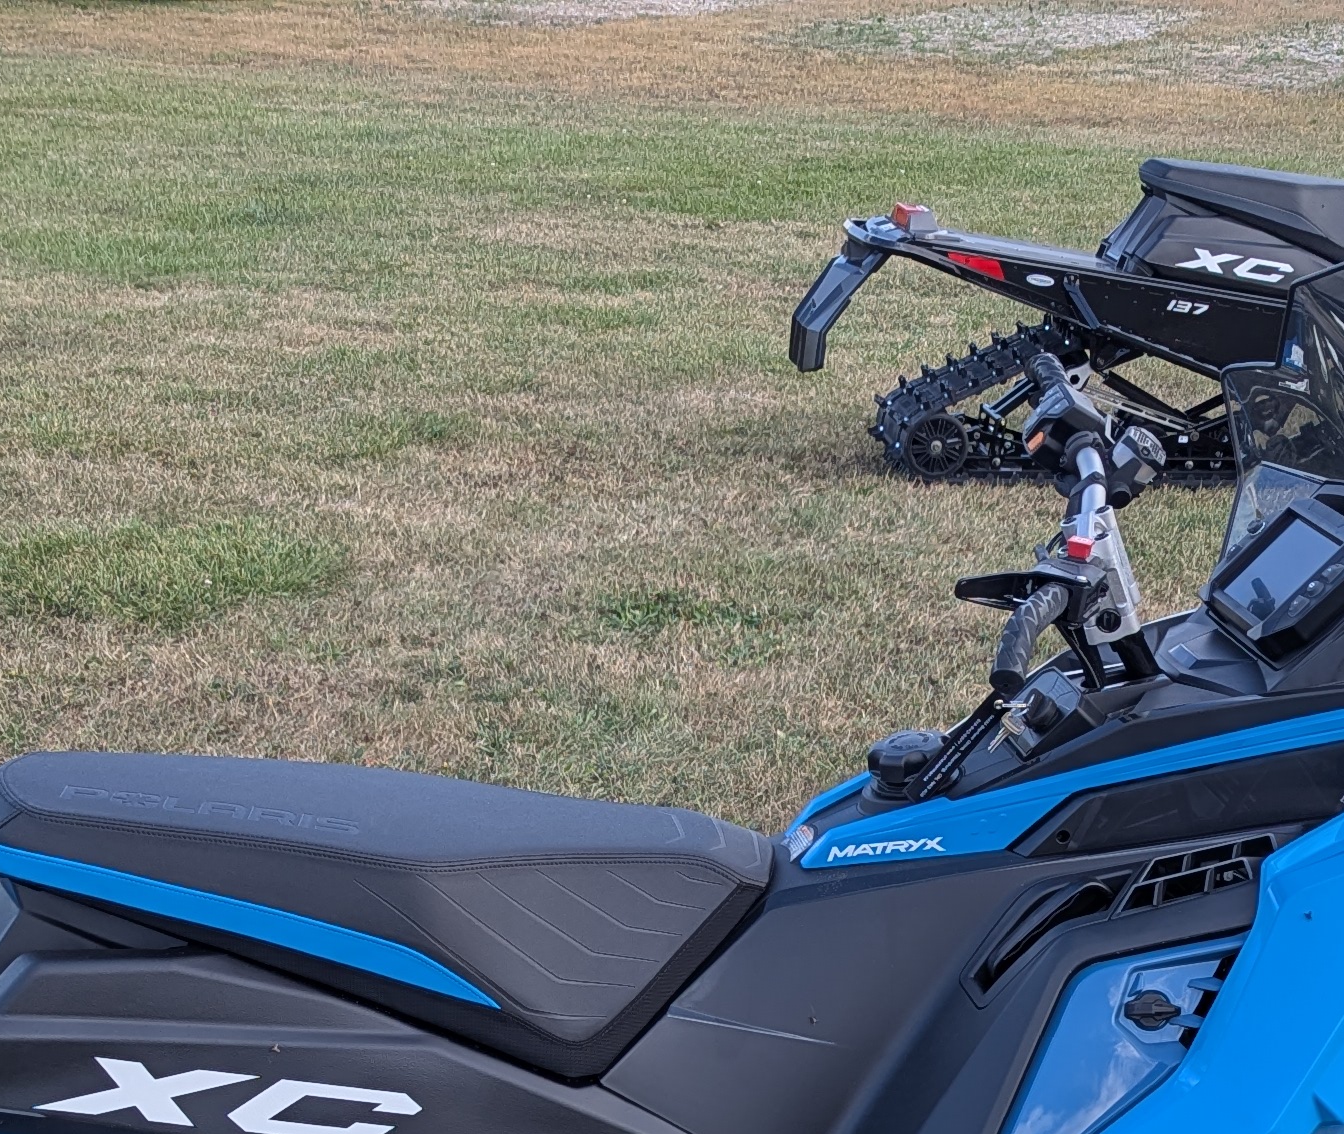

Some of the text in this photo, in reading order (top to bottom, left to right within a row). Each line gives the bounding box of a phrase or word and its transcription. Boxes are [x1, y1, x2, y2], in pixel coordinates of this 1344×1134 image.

[1174, 247, 1294, 283] XC
[1166, 299, 1209, 315] 137
[59, 784, 361, 835] POLARIS
[827, 836, 946, 862] MATRYX
